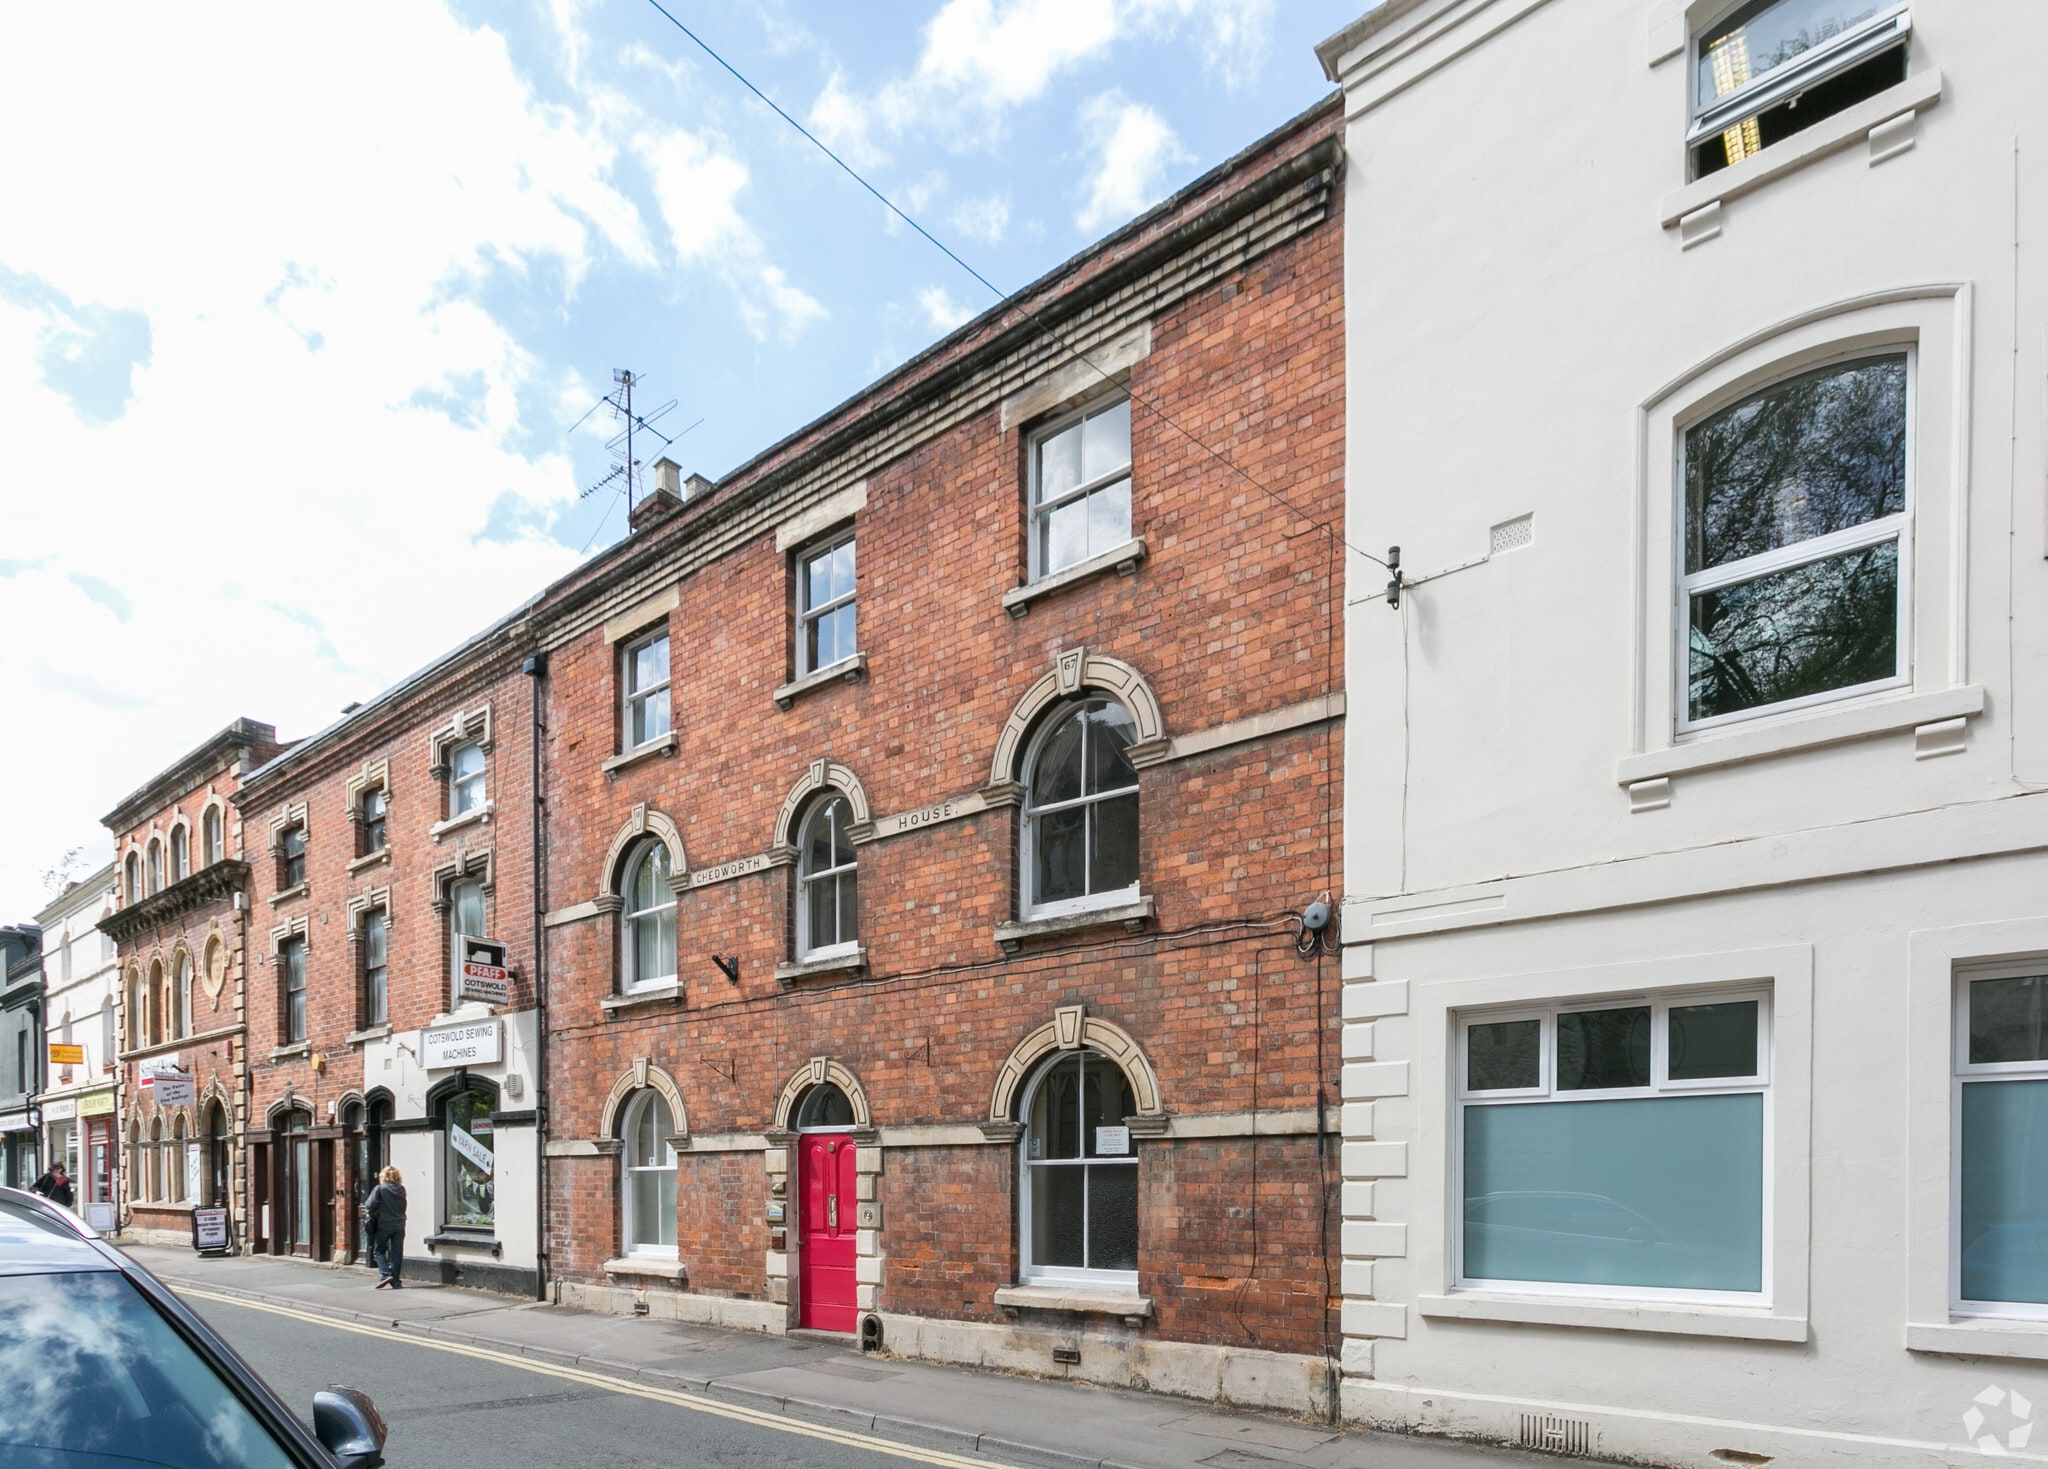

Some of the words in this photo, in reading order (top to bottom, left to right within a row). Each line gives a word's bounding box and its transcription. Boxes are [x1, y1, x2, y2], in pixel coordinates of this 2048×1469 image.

[1064, 658, 1076, 670] 67
[696, 858, 760, 883] CHEDWORTH
[469, 965, 501, 979] PFAFF
[464, 979, 507, 991] COTSWOLD
[428, 1030, 464, 1044] COTSWOLD
[465, 1025, 493, 1039] SEWING
[443, 1046, 477, 1060] MACHINES
